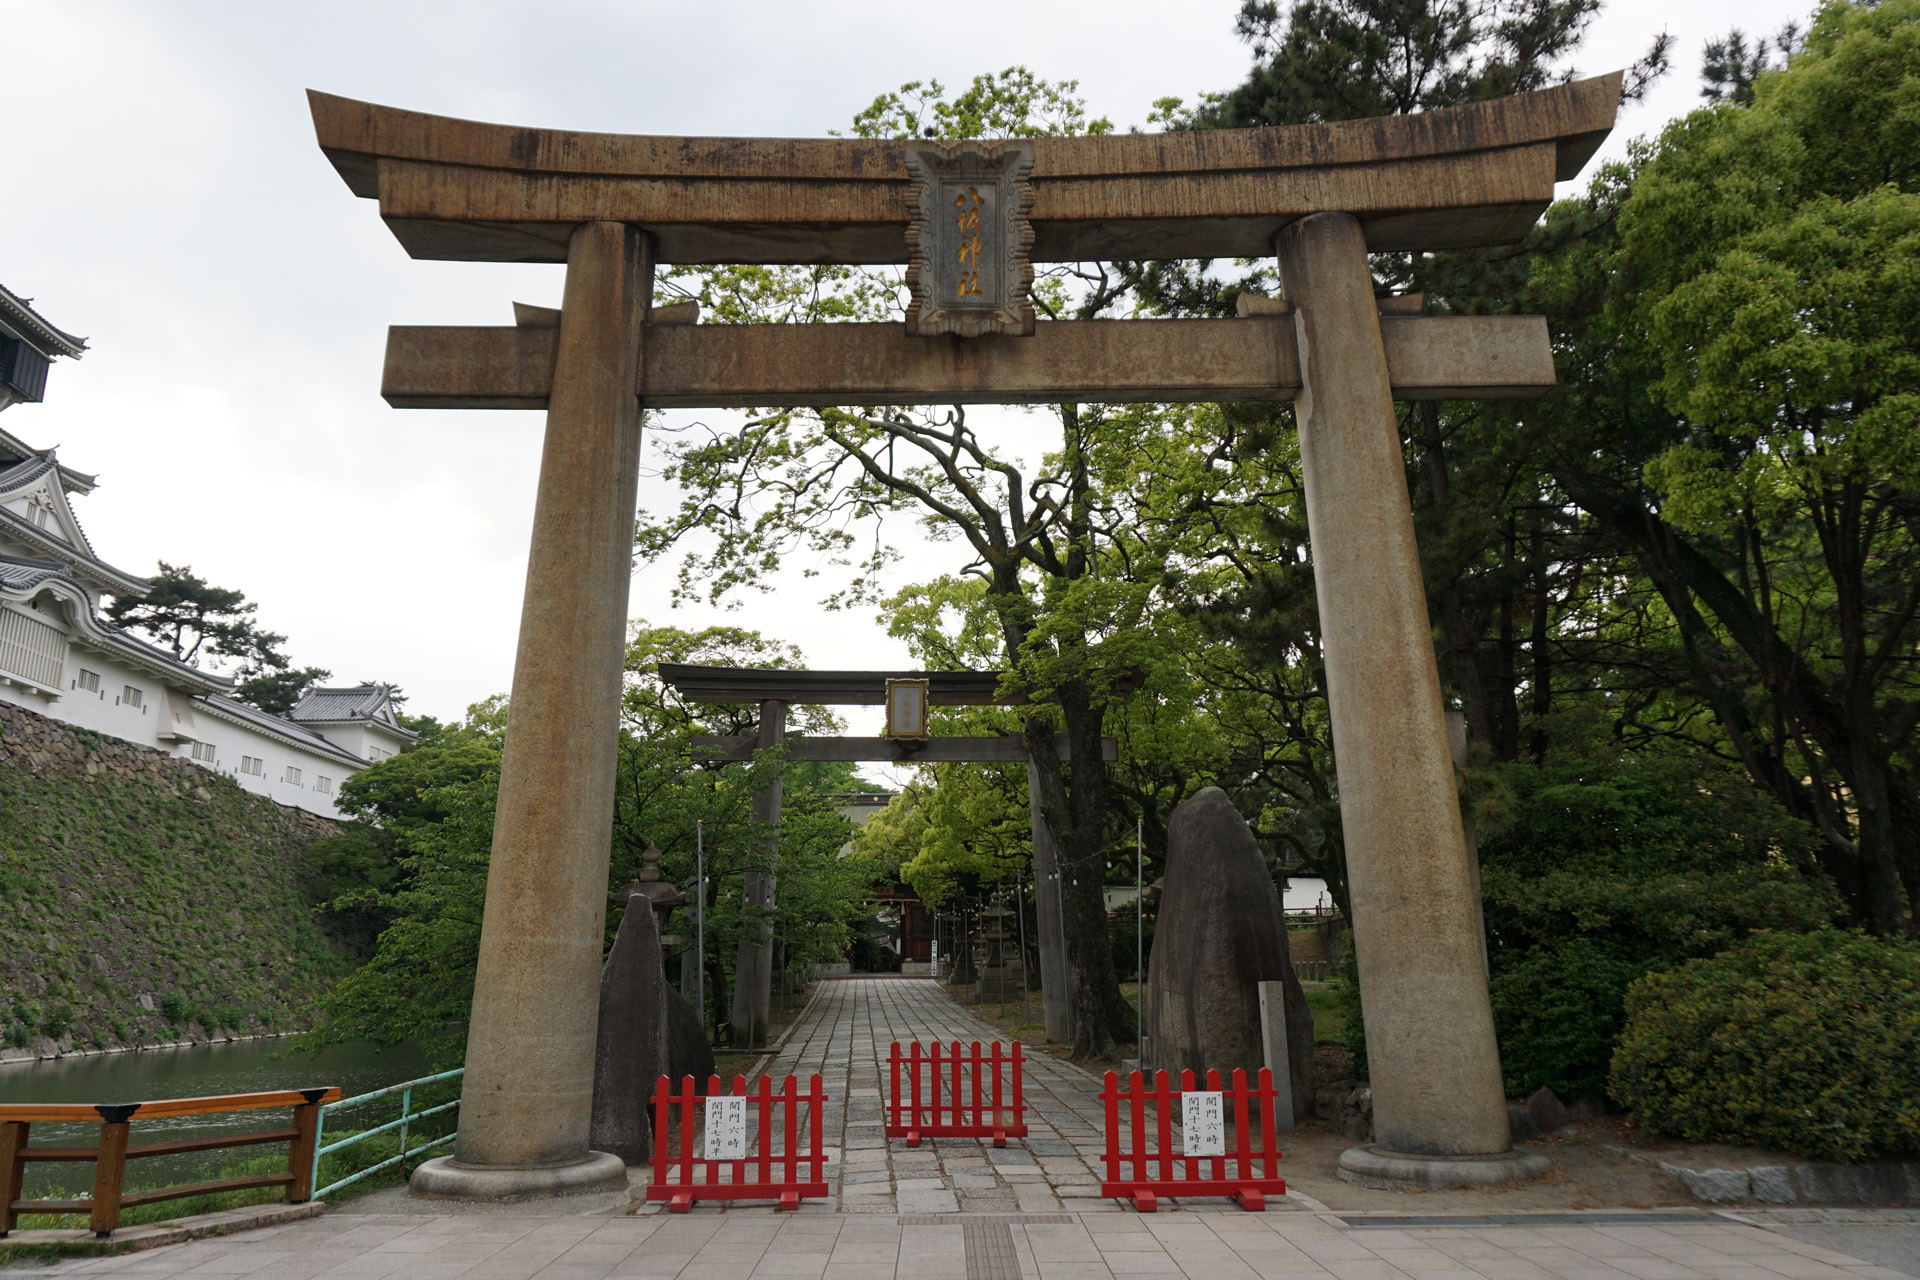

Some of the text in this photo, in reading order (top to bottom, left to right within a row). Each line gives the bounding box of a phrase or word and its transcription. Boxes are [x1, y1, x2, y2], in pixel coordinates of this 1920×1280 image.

[711, 1101, 723, 1156] 閉門十七時半
[727, 1101, 740, 1148] 開門六時
[1188, 1097, 1202, 1153] 閉門十七時半
[1206, 1097, 1219, 1144] 開門六時
